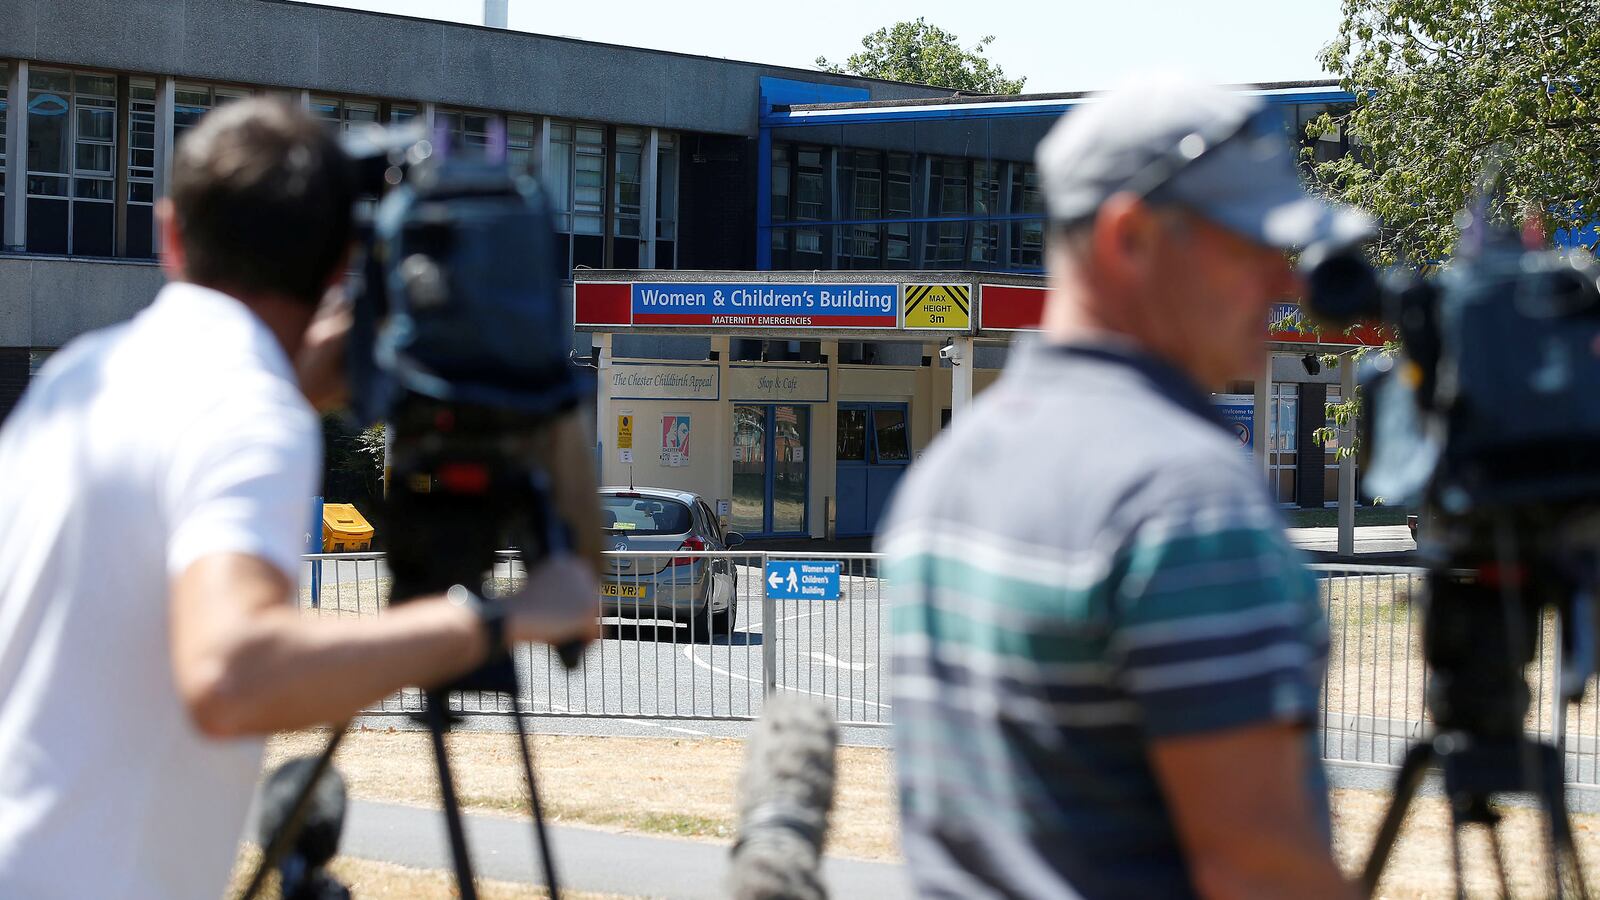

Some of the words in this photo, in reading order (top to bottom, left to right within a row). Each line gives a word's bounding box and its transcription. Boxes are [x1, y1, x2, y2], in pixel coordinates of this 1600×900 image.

[641, 289, 706, 306] Women
[712, 290, 725, 306] &
[731, 289, 814, 307] Children's
[820, 290, 892, 312] Building
[712, 316, 756, 324] MATERNITY
[758, 316, 812, 325] EMERGENCIES
[929, 314, 945, 323] 3m
[613, 372, 627, 386] The
[627, 373, 653, 386] Chester
[654, 374, 688, 387] Childbirth
[689, 374, 713, 392] Appeal
[757, 375, 774, 393] Shop
[774, 378, 781, 389] &
[802, 564, 824, 573] Women
[824, 564, 836, 573] and
[801, 586, 825, 596] Building
